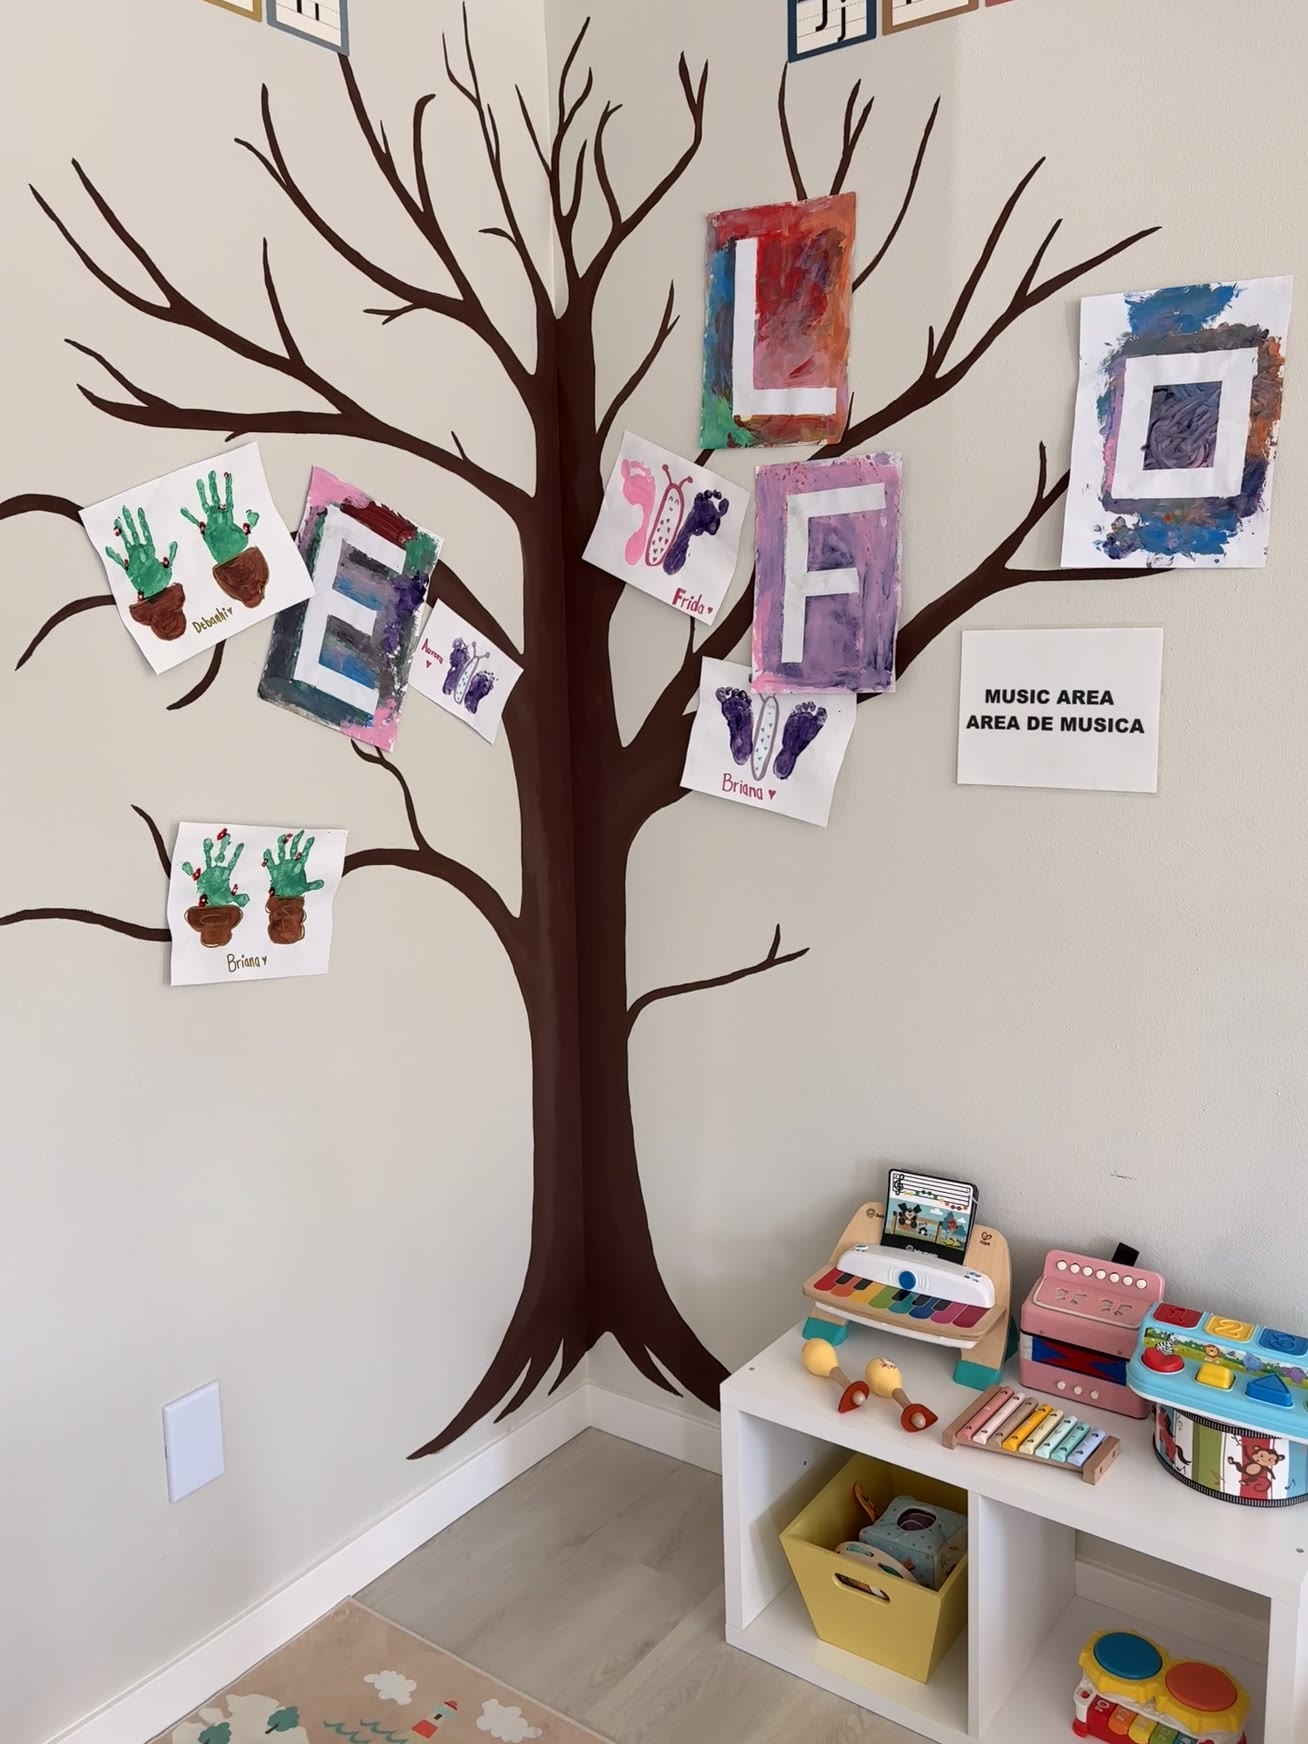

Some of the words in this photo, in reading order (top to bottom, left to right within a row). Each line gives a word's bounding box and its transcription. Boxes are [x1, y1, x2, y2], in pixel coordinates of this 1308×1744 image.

[732, 237, 837, 416] L
[781, 483, 886, 663] F
[293, 503, 407, 715] E
[671, 587, 705, 615] Frida
[192, 607, 229, 633] Debanhi
[985, 689, 1050, 704] MUSIC
[1056, 690, 1115, 705] AREA
[966, 715, 1020, 730] AREA
[1027, 716, 1053, 731] DE
[1060, 717, 1145, 734] MUSICA
[722, 773, 764, 800] Briana
[226, 953, 261, 972] Briana
[1214, 1319, 1243, 1338] 2
